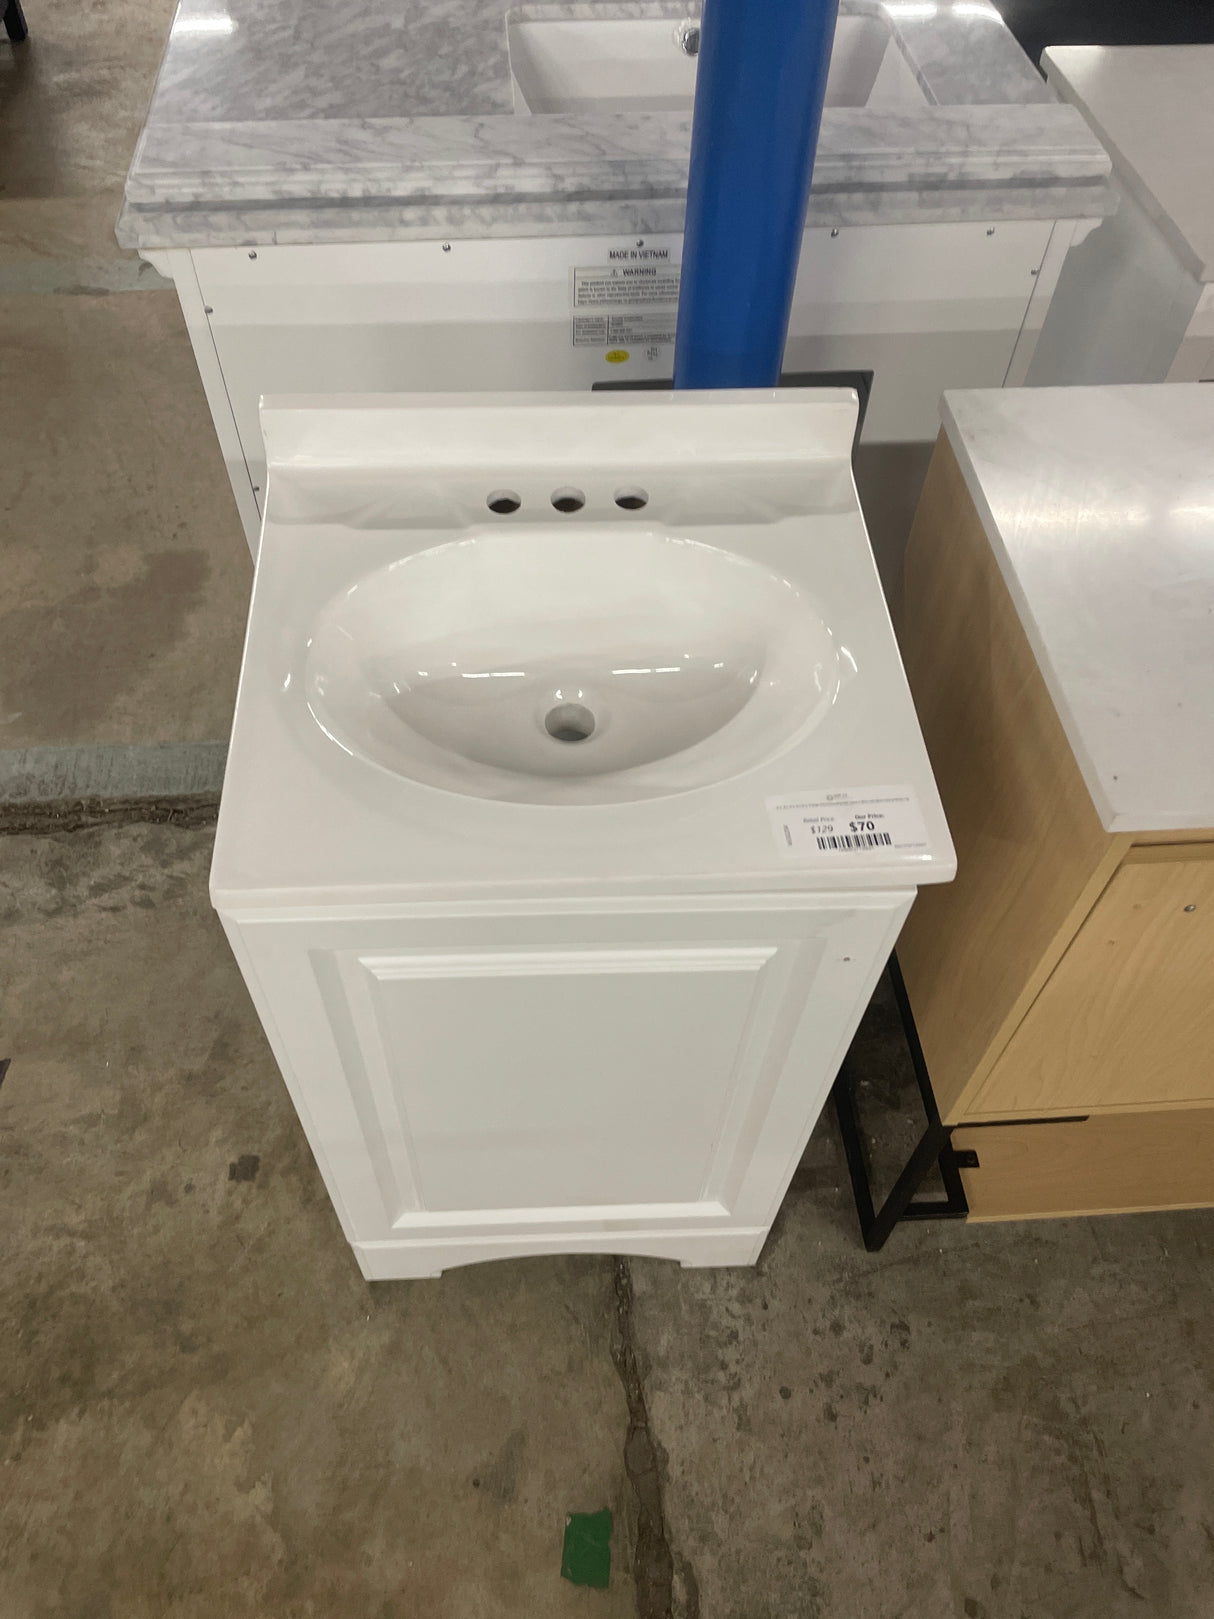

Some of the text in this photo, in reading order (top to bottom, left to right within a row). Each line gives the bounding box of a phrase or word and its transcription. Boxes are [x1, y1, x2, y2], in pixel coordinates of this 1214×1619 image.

[609, 249, 668, 259] MADE IN VIETNAM
[623, 268, 657, 277] WARNING
[811, 825, 834, 834] $129
[849, 821, 875, 833] $70
